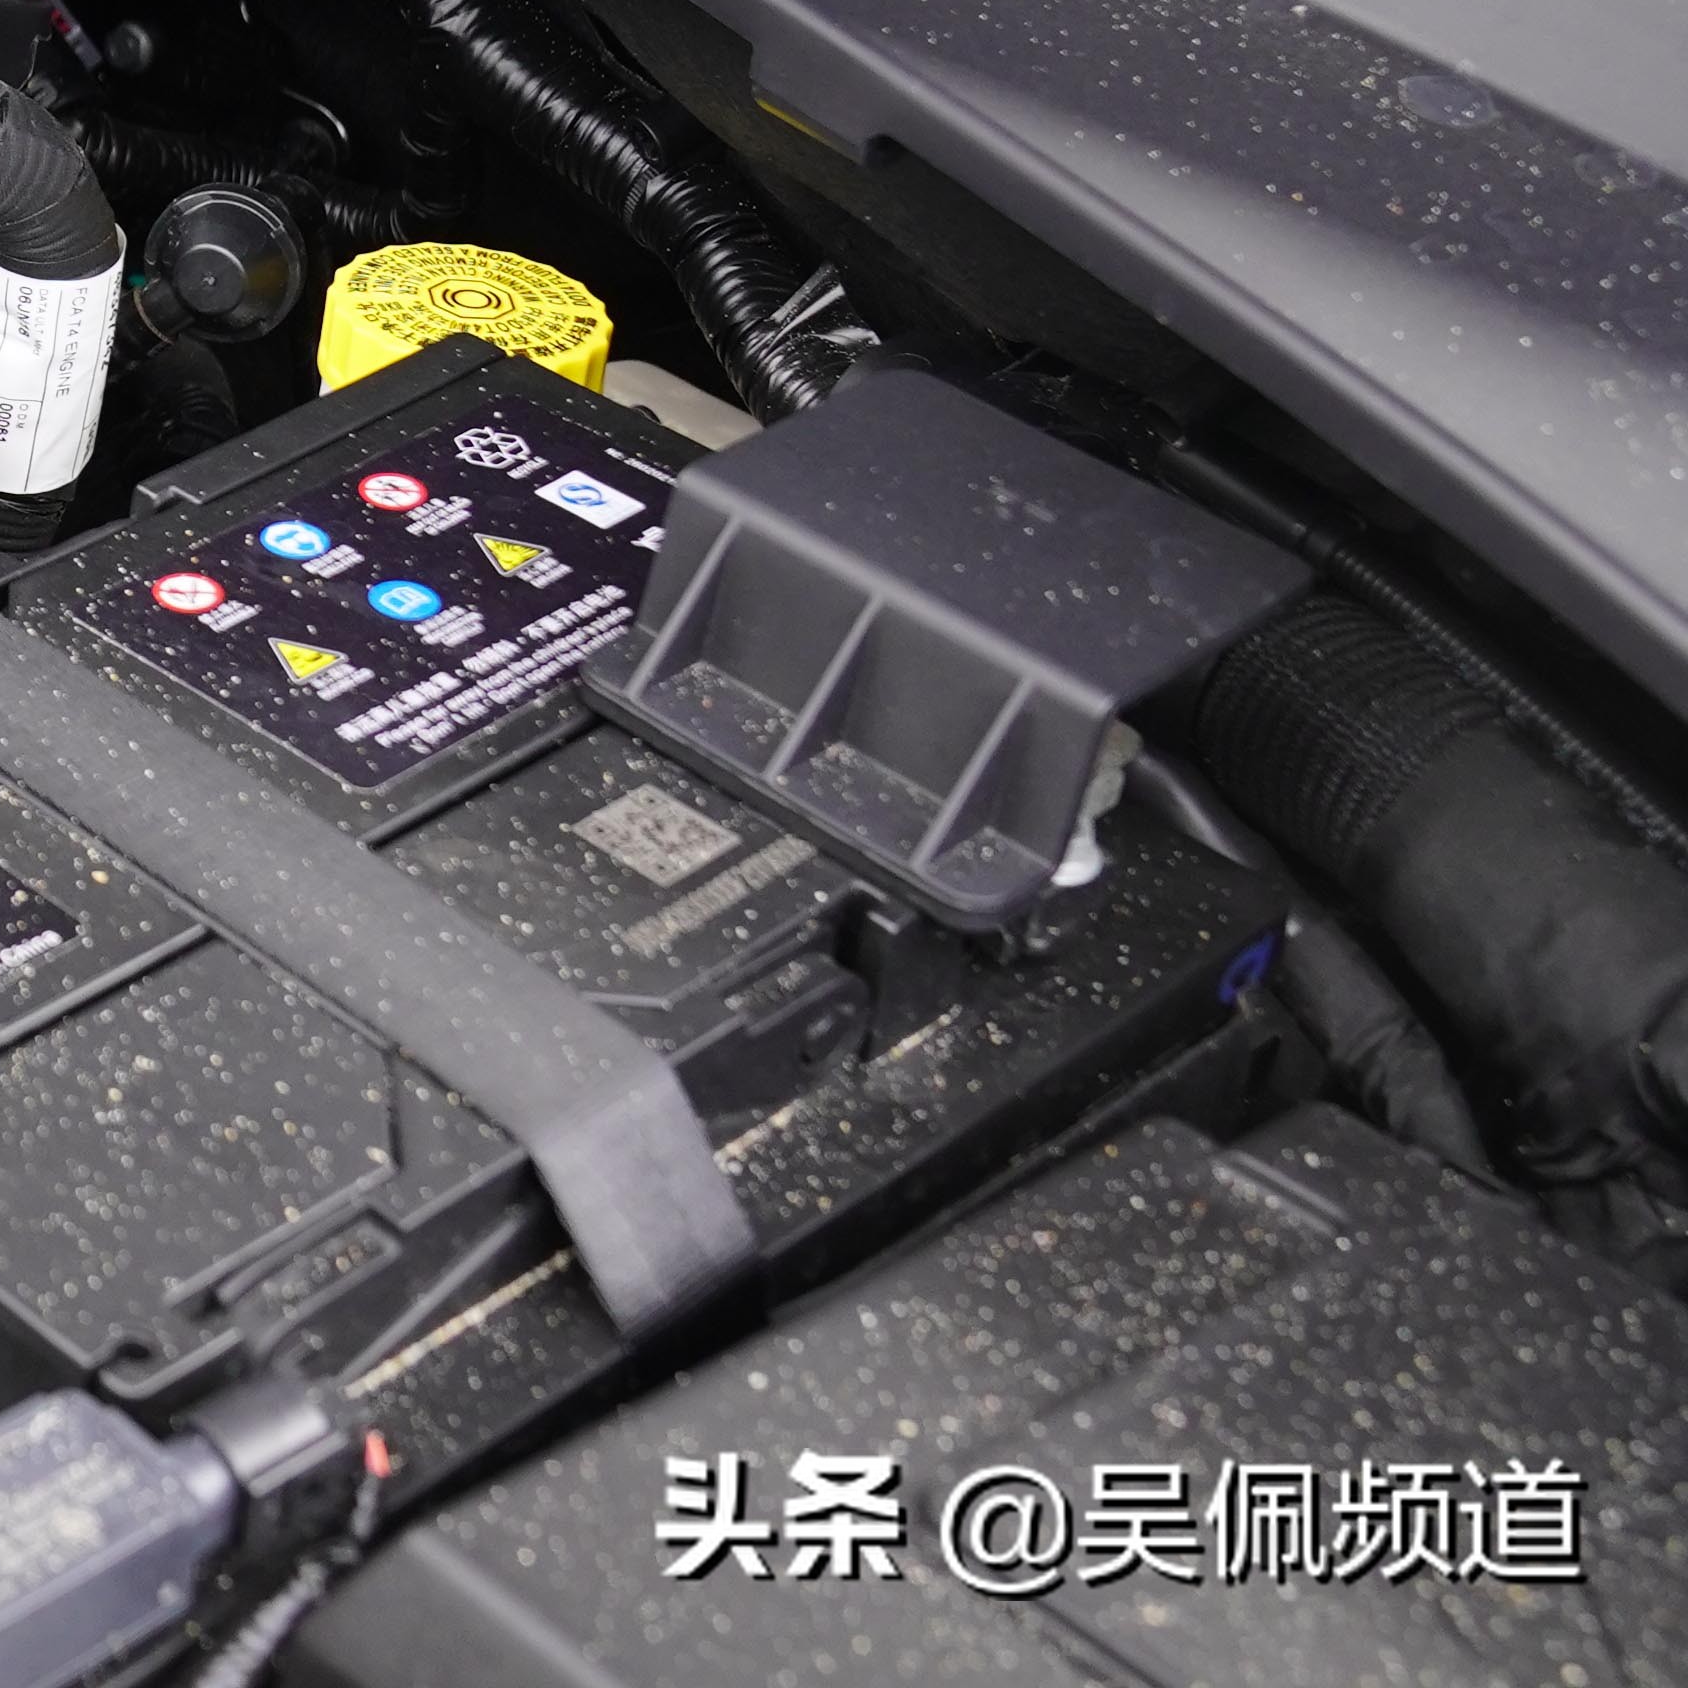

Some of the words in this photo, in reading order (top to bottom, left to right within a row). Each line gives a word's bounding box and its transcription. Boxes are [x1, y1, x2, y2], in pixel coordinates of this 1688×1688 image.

[392, 247, 454, 259] SEALED
[460, 248, 469, 256] A
[477, 251, 523, 266] FROM
[408, 257, 487, 268] REMOVING
[347, 255, 395, 293] CONTAINER
[425, 267, 477, 279] CLEAN
[493, 261, 550, 289] BEFORE
[525, 264, 569, 287] FLUID
[482, 270, 541, 302] WARNING
[72, 287, 88, 318] FCA
[541, 290, 567, 305] CAP
[56, 341, 77, 398] ENGINE
